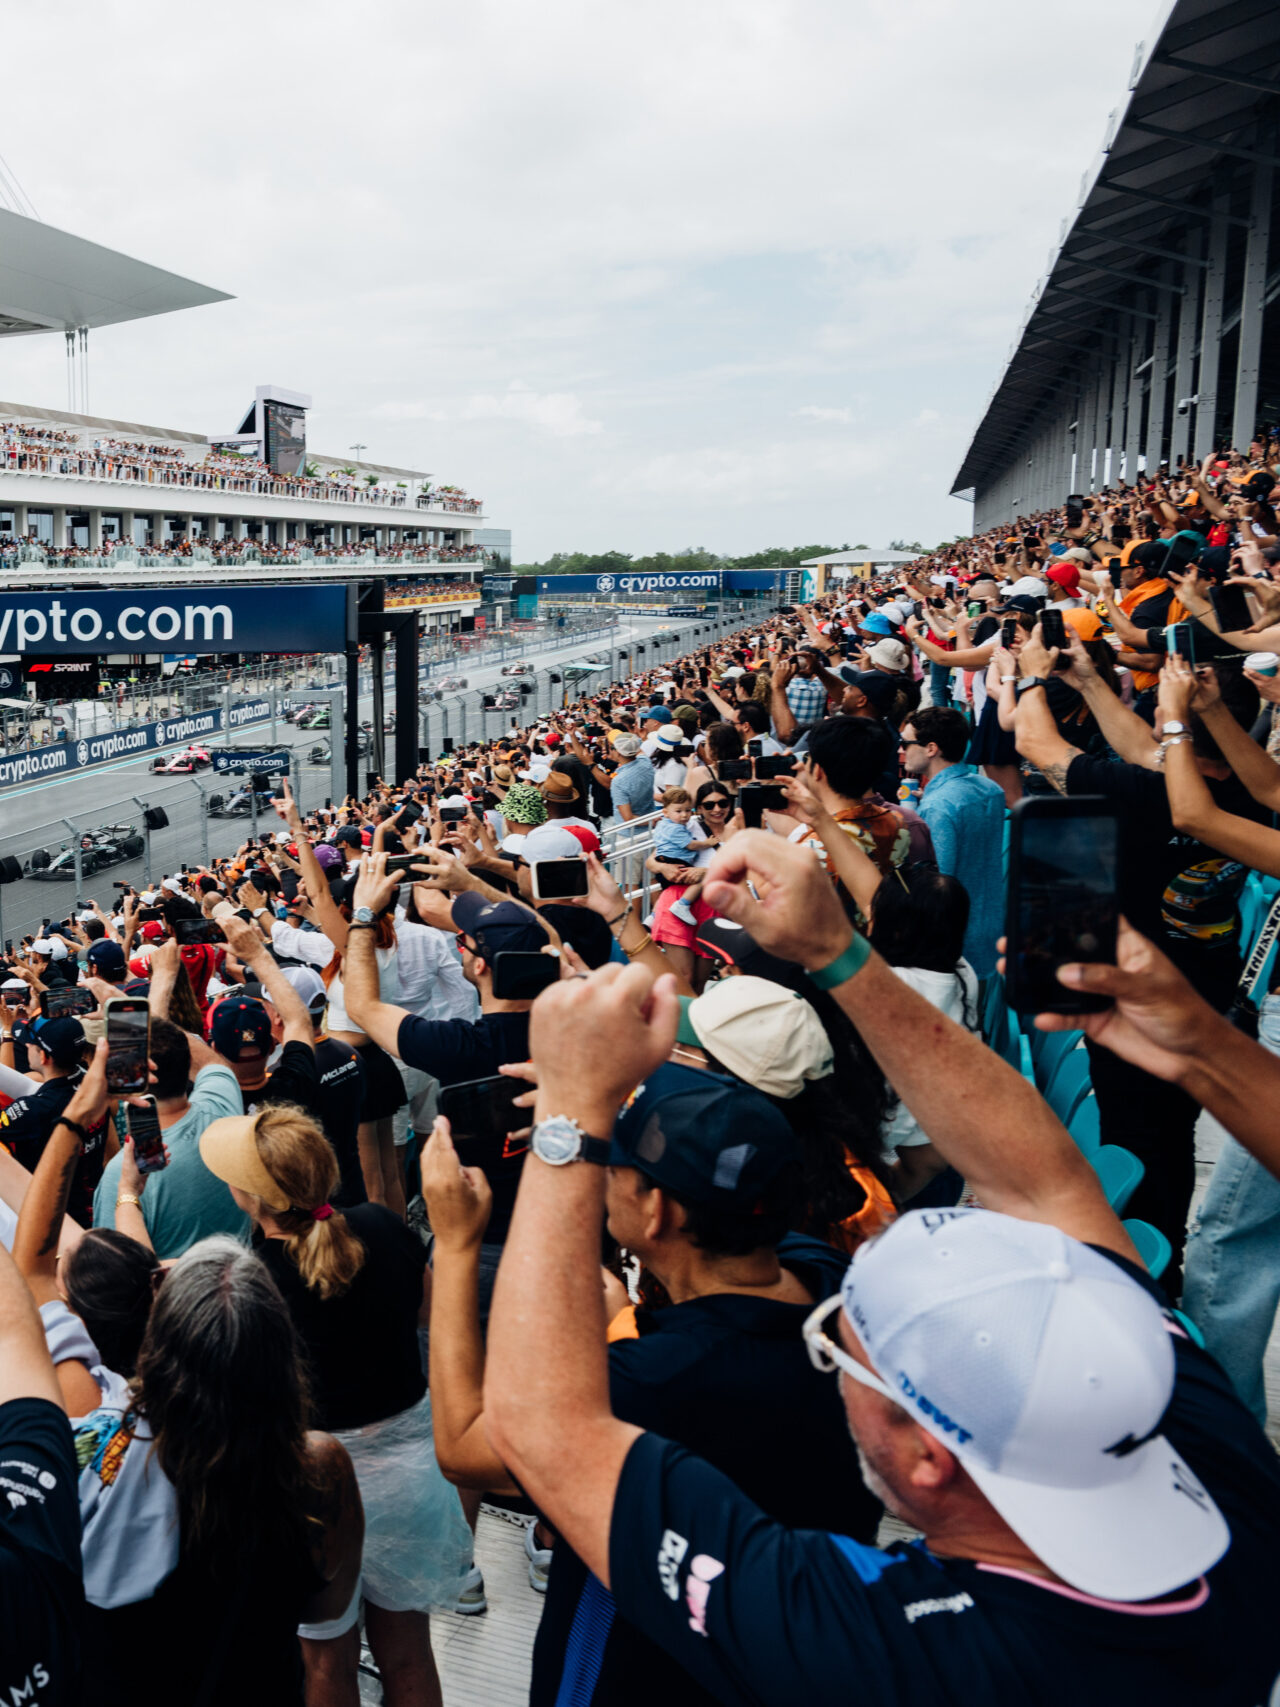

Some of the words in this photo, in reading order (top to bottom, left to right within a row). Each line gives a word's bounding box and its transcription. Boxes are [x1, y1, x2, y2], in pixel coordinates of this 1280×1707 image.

[620, 574, 718, 591] crypto.com
[802, 579, 817, 602] 19
[54, 662, 93, 672] SPRINT
[229, 701, 270, 724] crypto.com
[166, 714, 214, 740] crypto.com
[91, 730, 148, 759] crypto.com
[320, 1060, 358, 1084] McLaren
